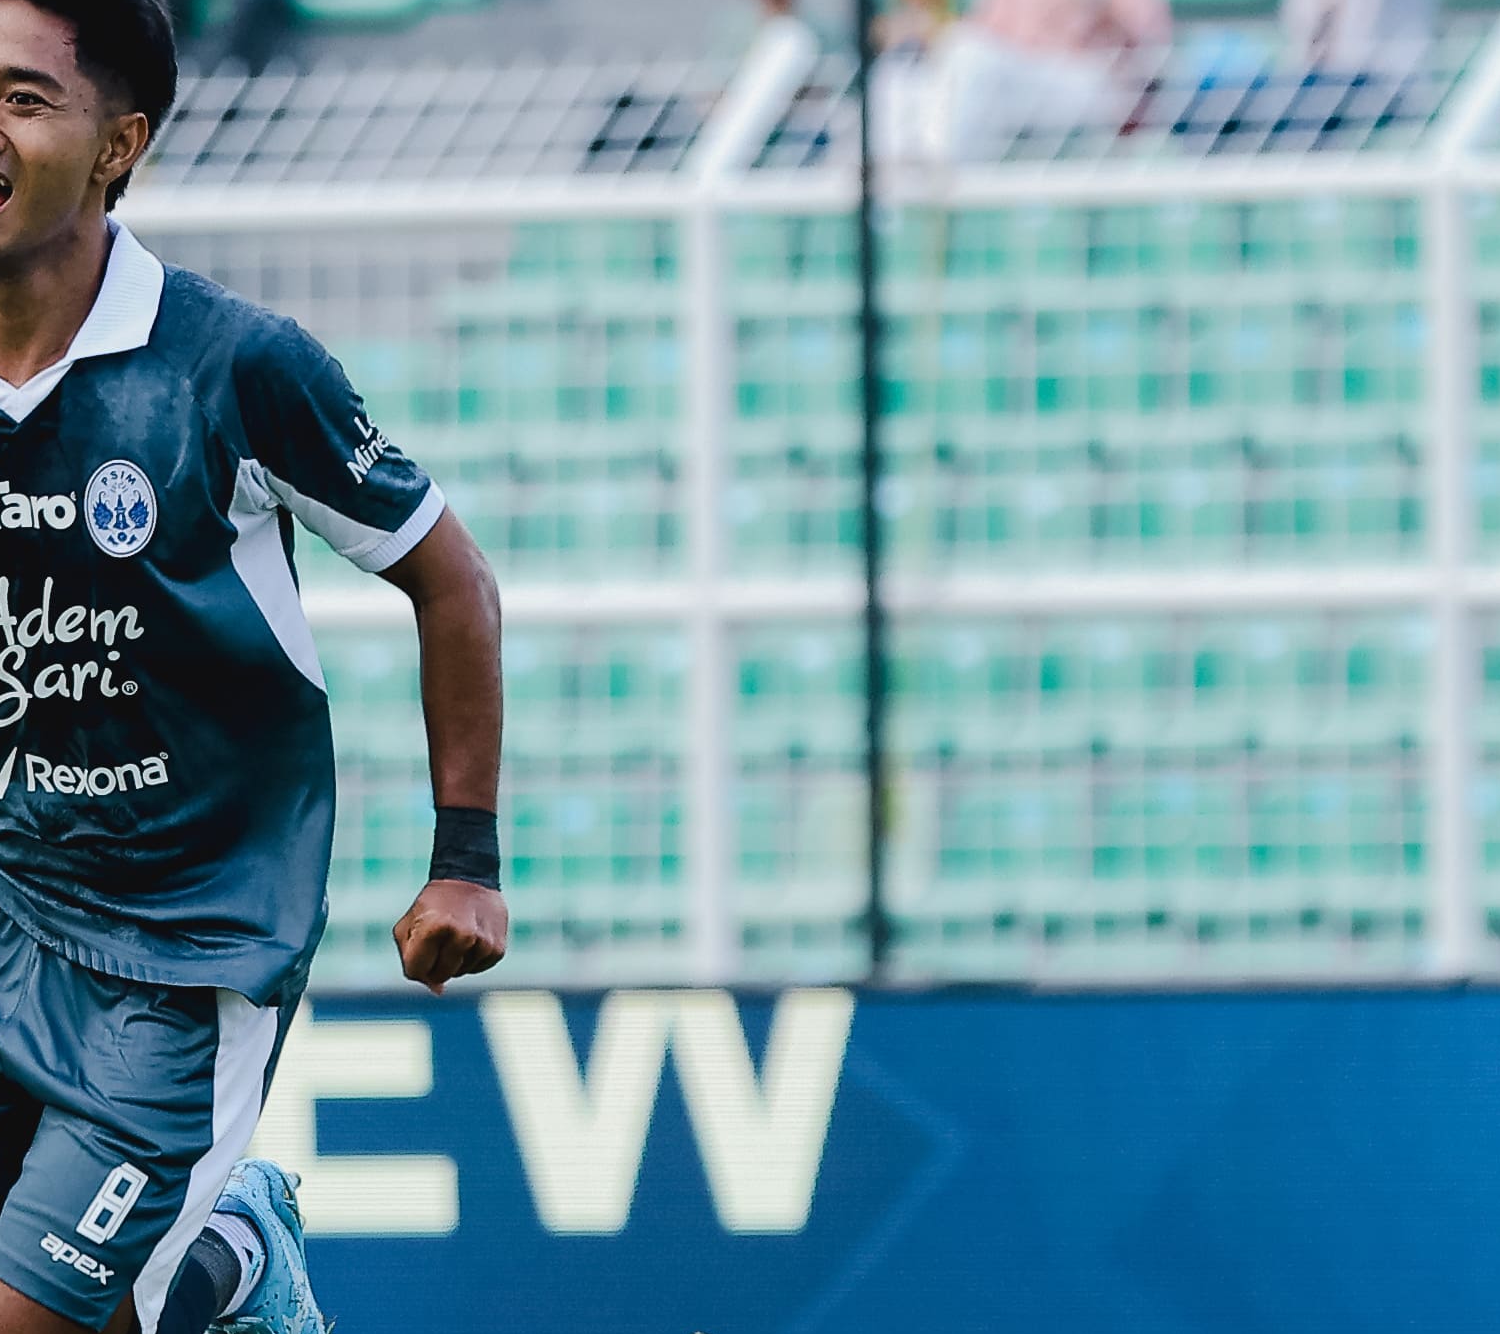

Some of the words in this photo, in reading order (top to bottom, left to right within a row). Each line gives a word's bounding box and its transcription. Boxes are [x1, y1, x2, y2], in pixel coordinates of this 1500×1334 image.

[101, 470, 136, 485] PSIM
[25, 751, 169, 798] Rexona
[75, 1161, 149, 1245] 8
[39, 1231, 115, 1286] apex
